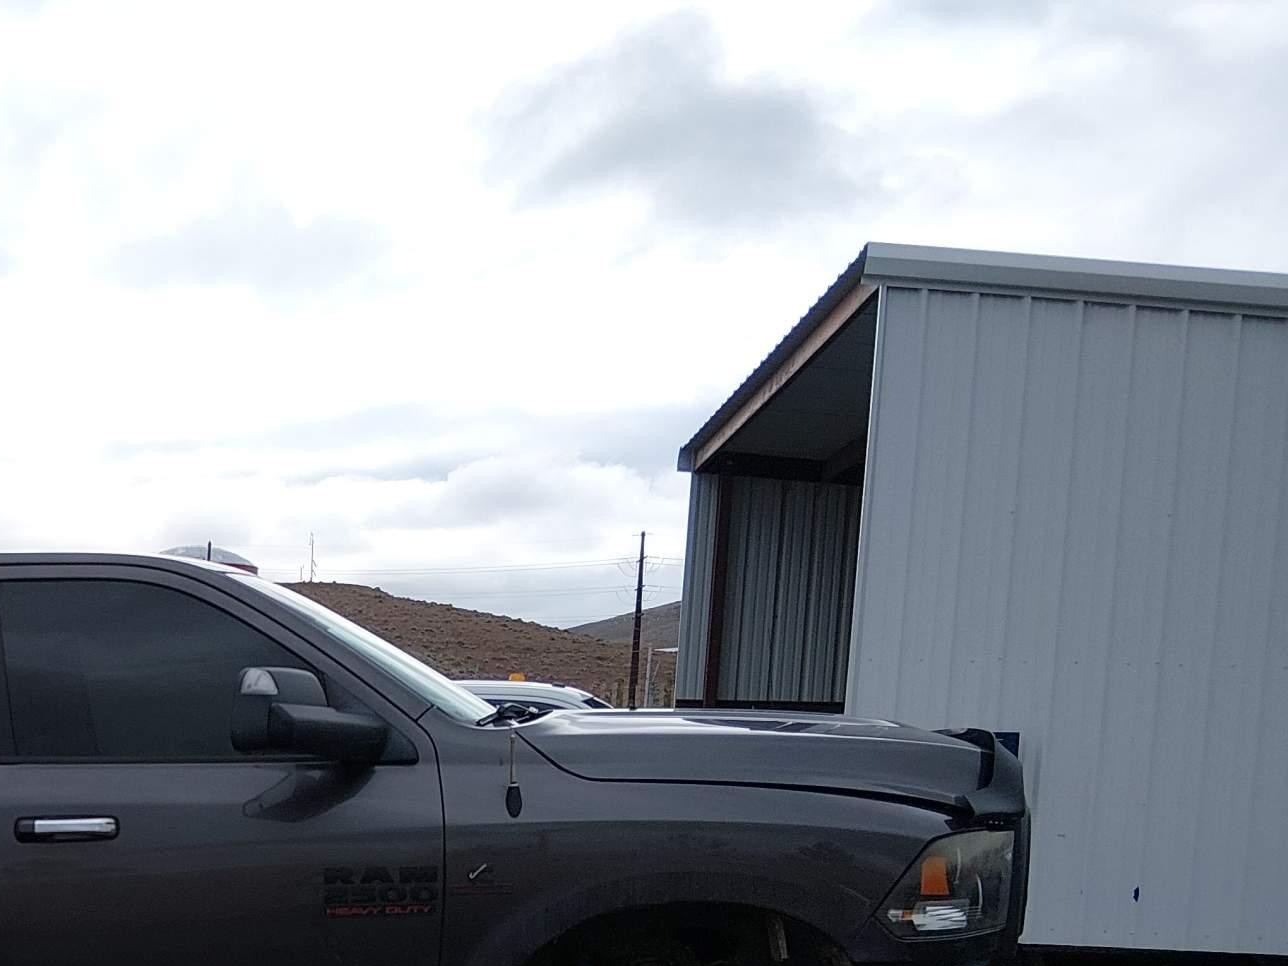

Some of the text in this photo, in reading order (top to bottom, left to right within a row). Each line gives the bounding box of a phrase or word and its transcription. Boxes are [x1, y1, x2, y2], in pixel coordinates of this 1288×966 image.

[324, 866, 438, 885] RAM
[327, 904, 432, 917] HEAVY DUTY
